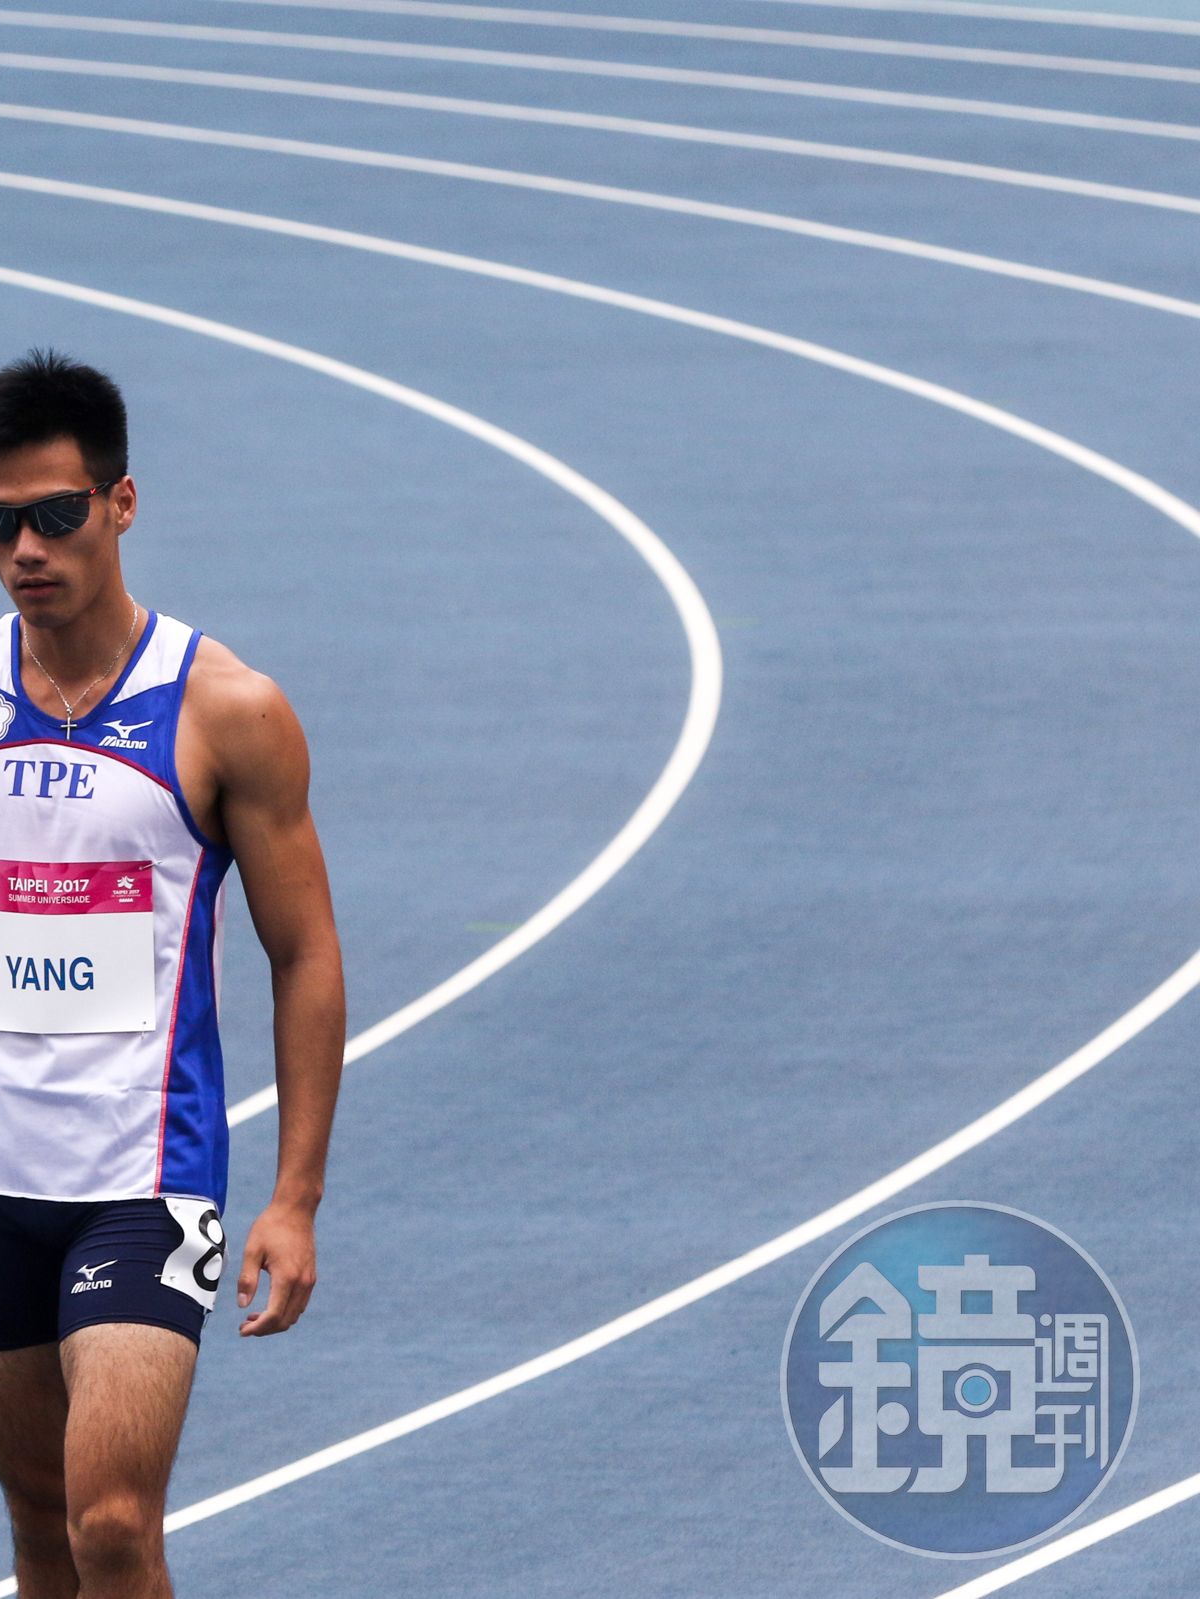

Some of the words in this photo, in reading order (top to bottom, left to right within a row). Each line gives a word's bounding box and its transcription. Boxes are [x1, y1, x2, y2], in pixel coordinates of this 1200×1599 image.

[4, 759, 96, 799] TPE
[8, 877, 48, 893] TAIPEI
[53, 879, 90, 893] 2017
[8, 893, 36, 903] SUMMER
[37, 895, 91, 904] UNIVERSIADE
[5, 955, 94, 991] YANG
[192, 1209, 227, 1292] 8
